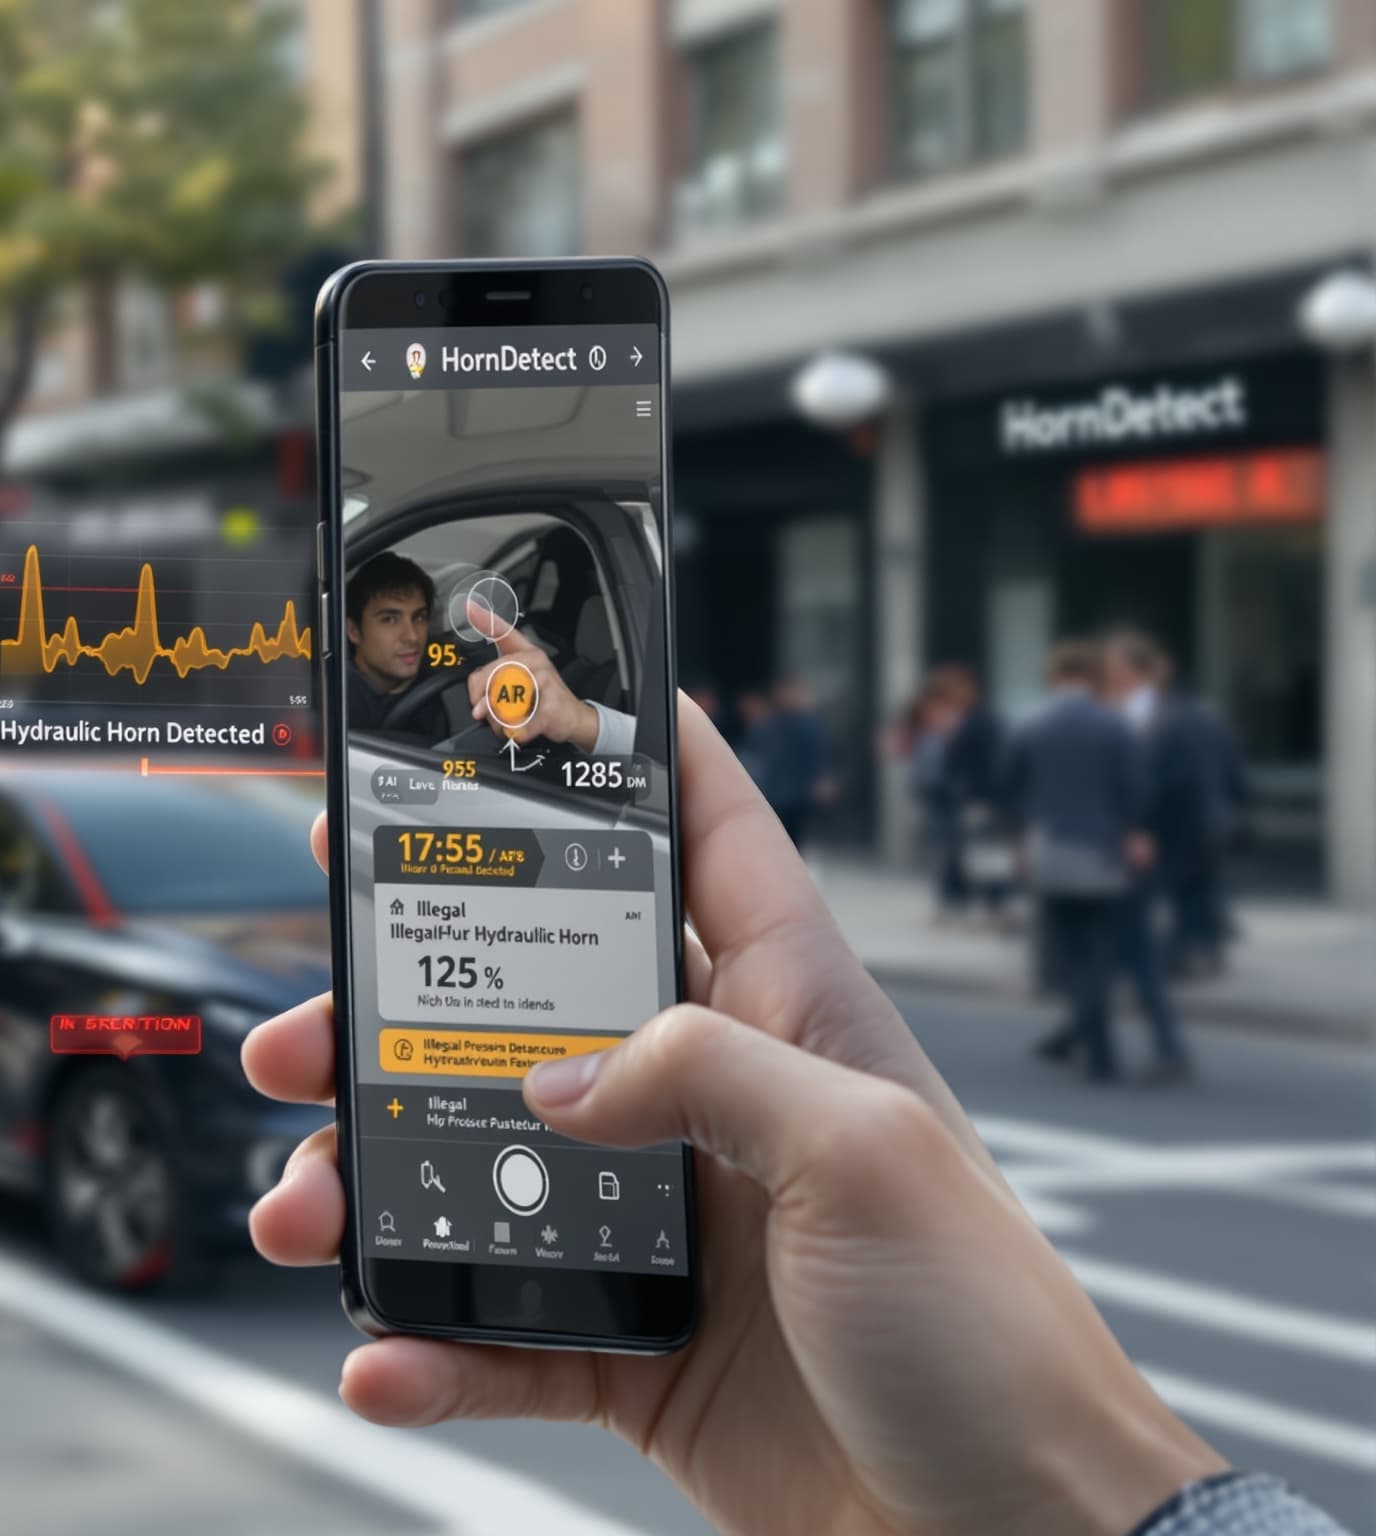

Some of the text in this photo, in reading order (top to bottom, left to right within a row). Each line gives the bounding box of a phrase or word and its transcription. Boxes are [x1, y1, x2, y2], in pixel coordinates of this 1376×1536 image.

[442, 345, 577, 372] HornDetect
[1000, 374, 1246, 452] HornDetect
[497, 684, 526, 704] AR
[442, 760, 476, 779] 955
[562, 761, 622, 788] 1285
[398, 832, 483, 863] 17:55
[417, 900, 466, 921] Illegal
[559, 928, 599, 946] Horn
[418, 955, 504, 990] 125 %
[428, 1096, 467, 1112] Illegal
